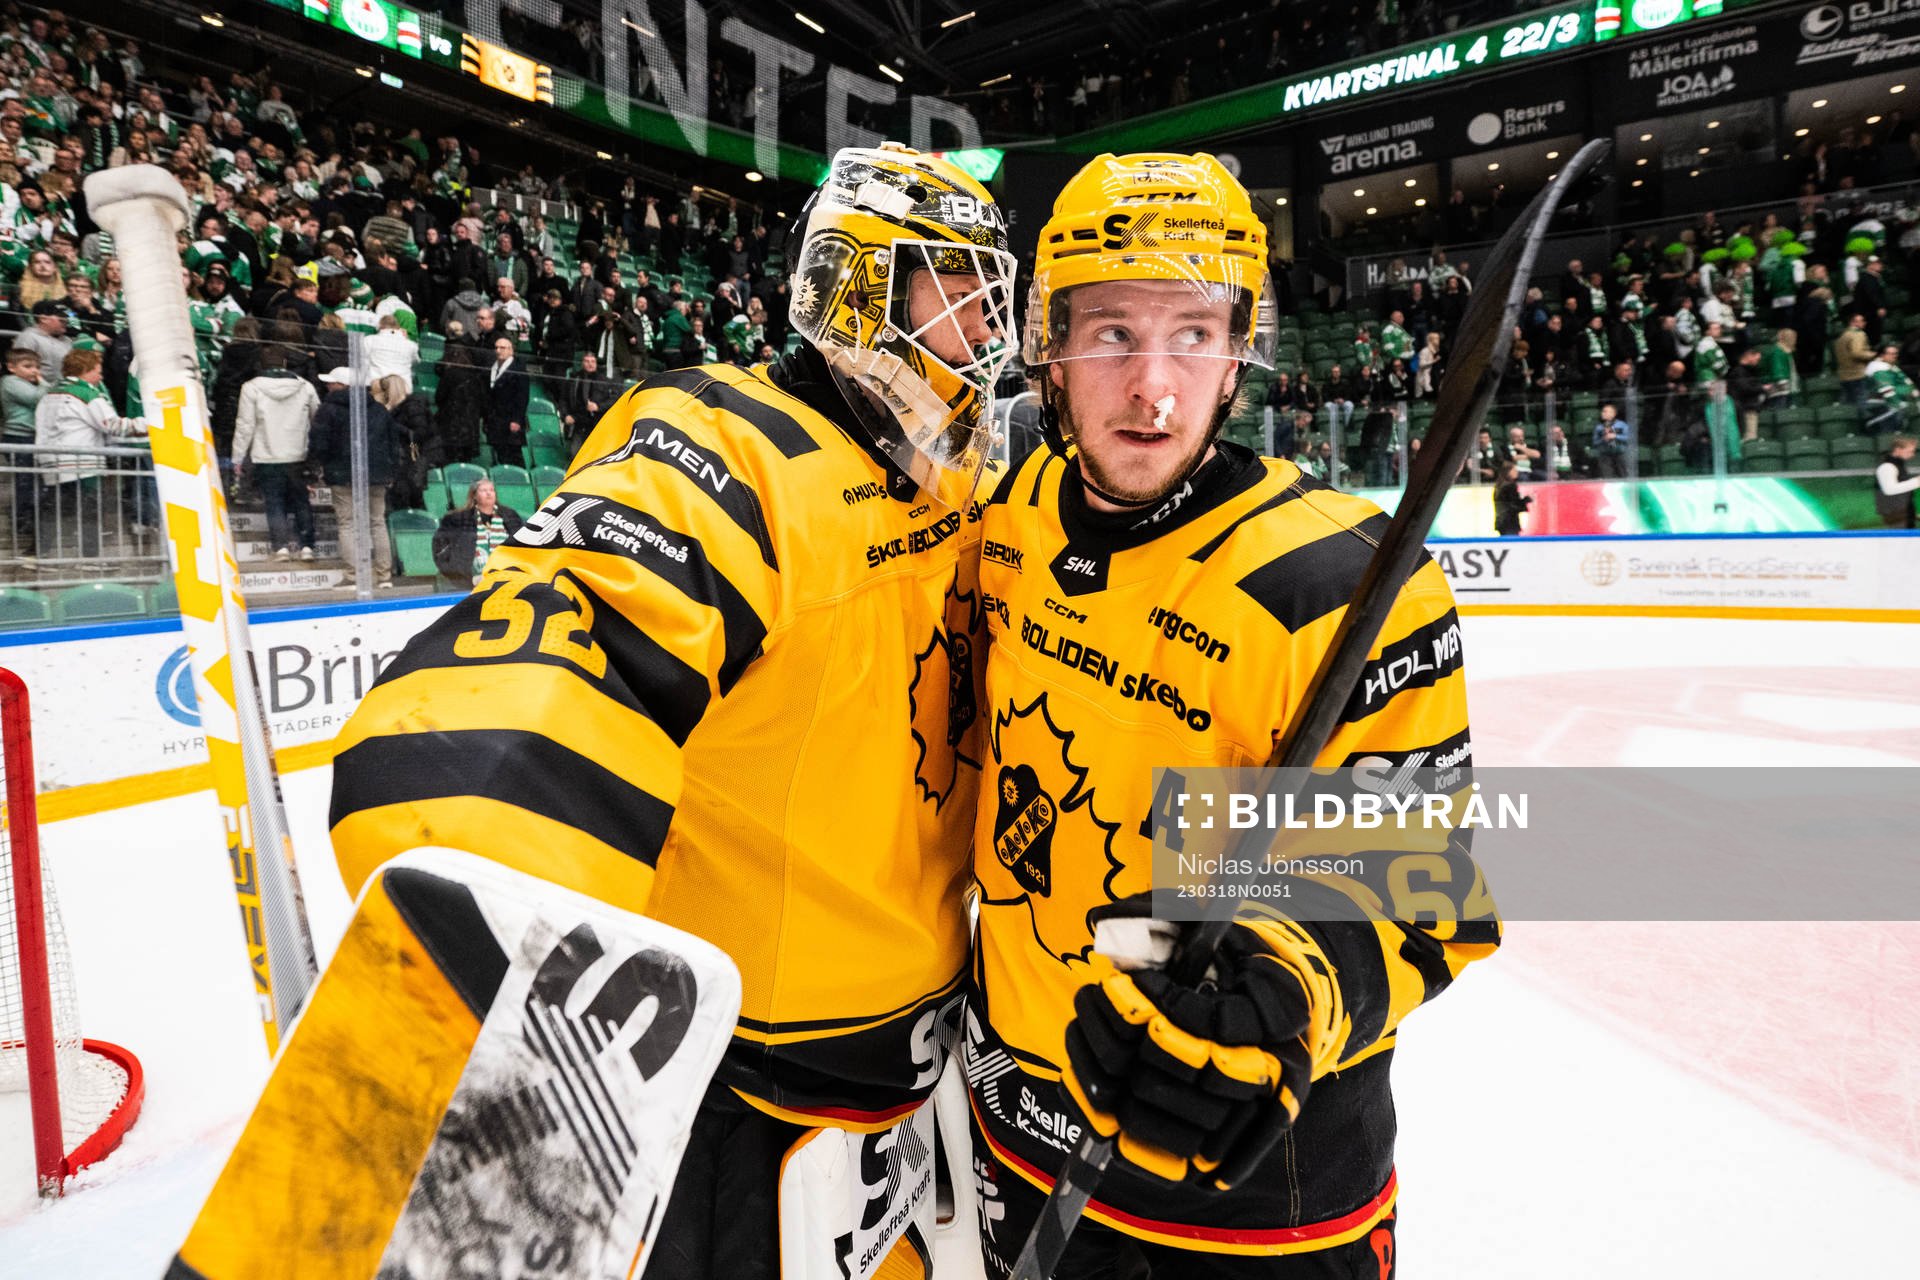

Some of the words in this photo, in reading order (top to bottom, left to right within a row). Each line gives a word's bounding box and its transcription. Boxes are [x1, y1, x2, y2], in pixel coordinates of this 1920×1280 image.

[1283, 54, 1460, 111] KVARTSFINAL
[1454, 36, 1488, 72] 4
[1501, 14, 1581, 58] 22/3
[1629, 41, 1759, 80] Målerifirma
[1657, 71, 1708, 98] JOA
[1504, 100, 1566, 123] Resurs
[1346, 129, 1391, 149] WIKLUND
[1391, 116, 1435, 140] TRADING
[1504, 119, 1548, 139] Bank
[1164, 218, 1226, 231] Skellefteå
[1164, 231, 1196, 242] Kraft
[908, 503, 931, 520] CCM
[592, 524, 643, 555] Kraft
[600, 510, 689, 564] Skellefteå
[1063, 556, 1096, 577] SHL
[1430, 549, 1510, 578] ASY
[1628, 557, 1701, 573] Svensk
[1706, 557, 1849, 574] FoodService
[453, 570, 608, 680] 32
[1044, 597, 1088, 625] CCM
[1021, 614, 1120, 687] BOLIDEN
[1120, 672, 1212, 732] skebo
[1435, 766, 1462, 793] Kraft
[1024, 860, 1046, 887] 1921
[1018, 1085, 1083, 1145] Skelle
[859, 1198, 911, 1275] Skellefteå
[911, 1169, 932, 1207] Kraft
